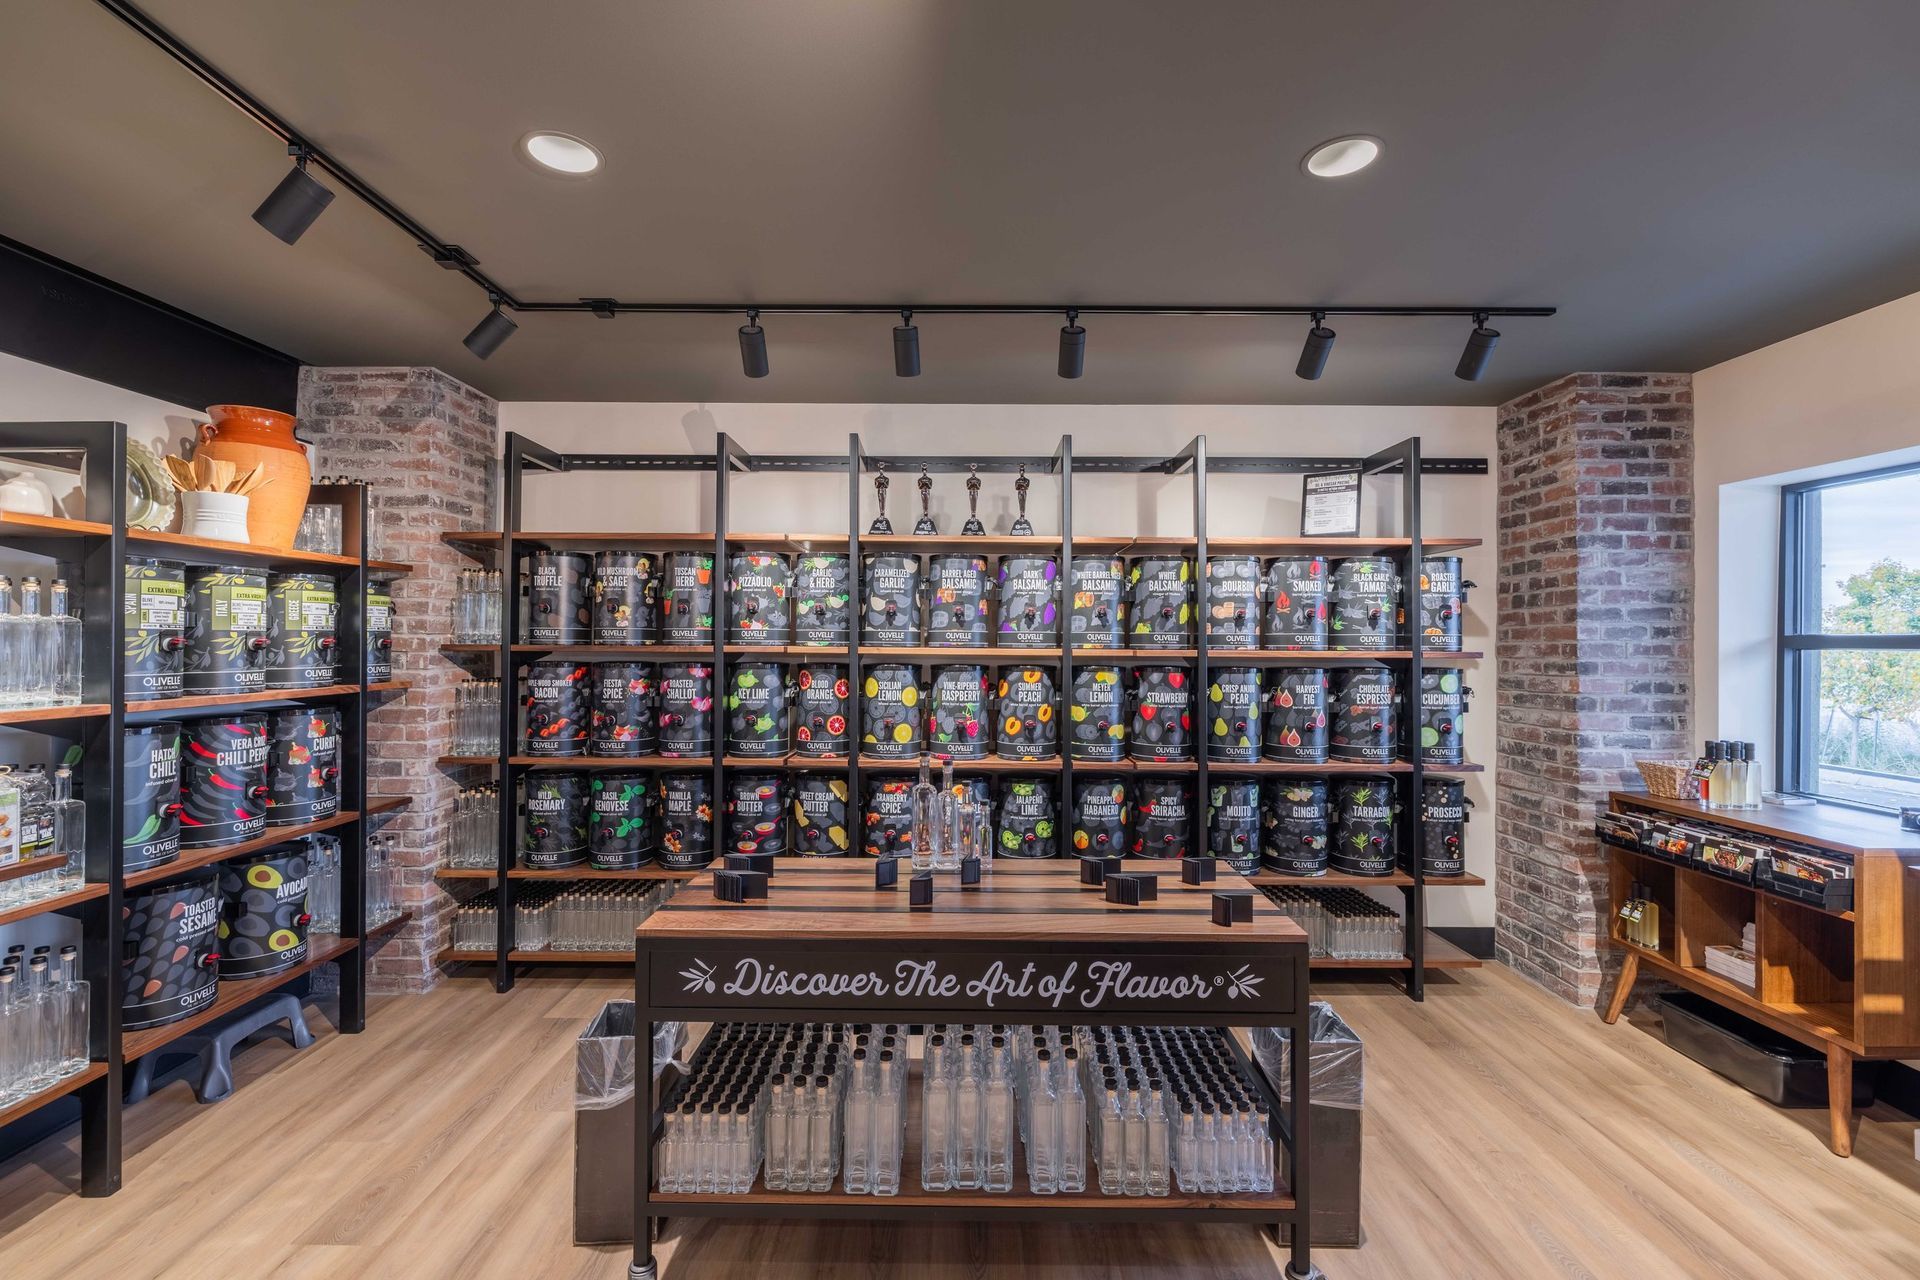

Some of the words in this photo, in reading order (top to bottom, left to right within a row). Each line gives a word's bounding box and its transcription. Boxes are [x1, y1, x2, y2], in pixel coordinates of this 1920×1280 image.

[538, 566, 556, 575] BLACK
[812, 569, 832, 577] GARLIC
[942, 570, 962, 578] BARREL
[962, 570, 976, 578] AGED
[1023, 570, 1039, 578] DARK
[1158, 572, 1176, 580] WHITE
[1354, 574, 1372, 582] BLACK
[534, 576, 562, 587] TRUFFLE
[602, 576, 608, 586] &
[608, 576, 628, 587] SAGE
[676, 576, 694, 587] HERB
[809, 578, 815, 588] &
[816, 578, 835, 588] HERB
[880, 578, 904, 588] GARLIC
[942, 579, 976, 590] BALSAMIC
[1013, 580, 1048, 590] BALSAMIC
[1082, 580, 1116, 590] BALSAMIC
[1149, 580, 1184, 591] BALSAMIC
[1222, 581, 1254, 591] BOURBON
[1293, 581, 1321, 591] SMOKED
[1360, 582, 1386, 592] TAMARI
[1431, 582, 1456, 592] GARLIC
[125, 594, 136, 614] SPAIN
[216, 600, 228, 616] ITALY
[234, 672, 264, 682] OLIVELLE
[305, 669, 332, 678] OLIVELLE
[144, 676, 180, 686] OLIVELLE
[604, 680, 622, 688] FIESTA
[670, 680, 694, 688] ROASTED
[812, 680, 828, 688] BLOOD
[878, 681, 902, 690] SICILIAN
[1018, 682, 1042, 690] SUMMER
[1092, 683, 1111, 692] MEYER
[1222, 684, 1239, 693] CRISP
[1296, 685, 1320, 693] HARVEST
[1359, 685, 1390, 694] CHOCOLATE
[534, 688, 558, 698] BACON
[602, 688, 623, 698] SPICE
[666, 688, 696, 699] SHALLOT
[738, 689, 750, 700] KEY
[752, 689, 770, 700] LIME
[806, 689, 834, 700] ORANGE
[878, 690, 902, 700] LEMON
[942, 690, 980, 701] RASPBERRY
[1018, 691, 1042, 702] PEACH
[1090, 692, 1113, 702] LEMON
[1147, 692, 1188, 704] STRAWBERRY
[1230, 694, 1249, 704] PEAR
[1304, 694, 1315, 704] FIG
[1356, 694, 1392, 704] ESPRESSO
[1422, 694, 1460, 704] CUCUMBER
[231, 737, 252, 750] VERA
[313, 736, 336, 751] CURRY
[152, 748, 175, 762] HATCH
[216, 748, 246, 766] CHILI
[150, 760, 176, 779] CHILE
[538, 792, 552, 800] WILD
[602, 792, 618, 800] BASIL
[669, 792, 692, 800] VANILLA
[740, 792, 760, 800] BROWN
[800, 792, 814, 800] SWEET
[815, 792, 834, 800] CREAM
[876, 794, 906, 802] CRANBERRY
[1160, 796, 1178, 805] SPICY
[312, 799, 336, 811] OLIVELLE
[528, 800, 566, 810] ROSEMARY
[595, 801, 629, 812] GENOVESE
[668, 800, 692, 811] MAPLE
[737, 801, 763, 812] BUTTER
[804, 801, 828, 812] BUTTER
[882, 802, 902, 813] SPICE
[1022, 804, 1038, 815] LIME
[1084, 805, 1118, 816] HABANERO
[1150, 806, 1185, 816] SRIRACHA
[1226, 806, 1252, 816] MOJITO
[1293, 806, 1318, 818] GINGER
[1428, 806, 1462, 818] PROSECCO
[234, 817, 265, 832] OLIVELLE
[143, 839, 178, 856] OLIVELLE
[276, 876, 308, 899] AVOCAD
[183, 897, 216, 918] TOASTED
[179, 909, 217, 934] SESAME
[281, 944, 307, 960] OLIVELLE
[723, 958, 890, 996] Discover
[894, 960, 960, 996] The
[966, 960, 1036, 1008] Art
[1038, 961, 1078, 1008] of
[180, 984, 216, 1006] OLIVELLE
